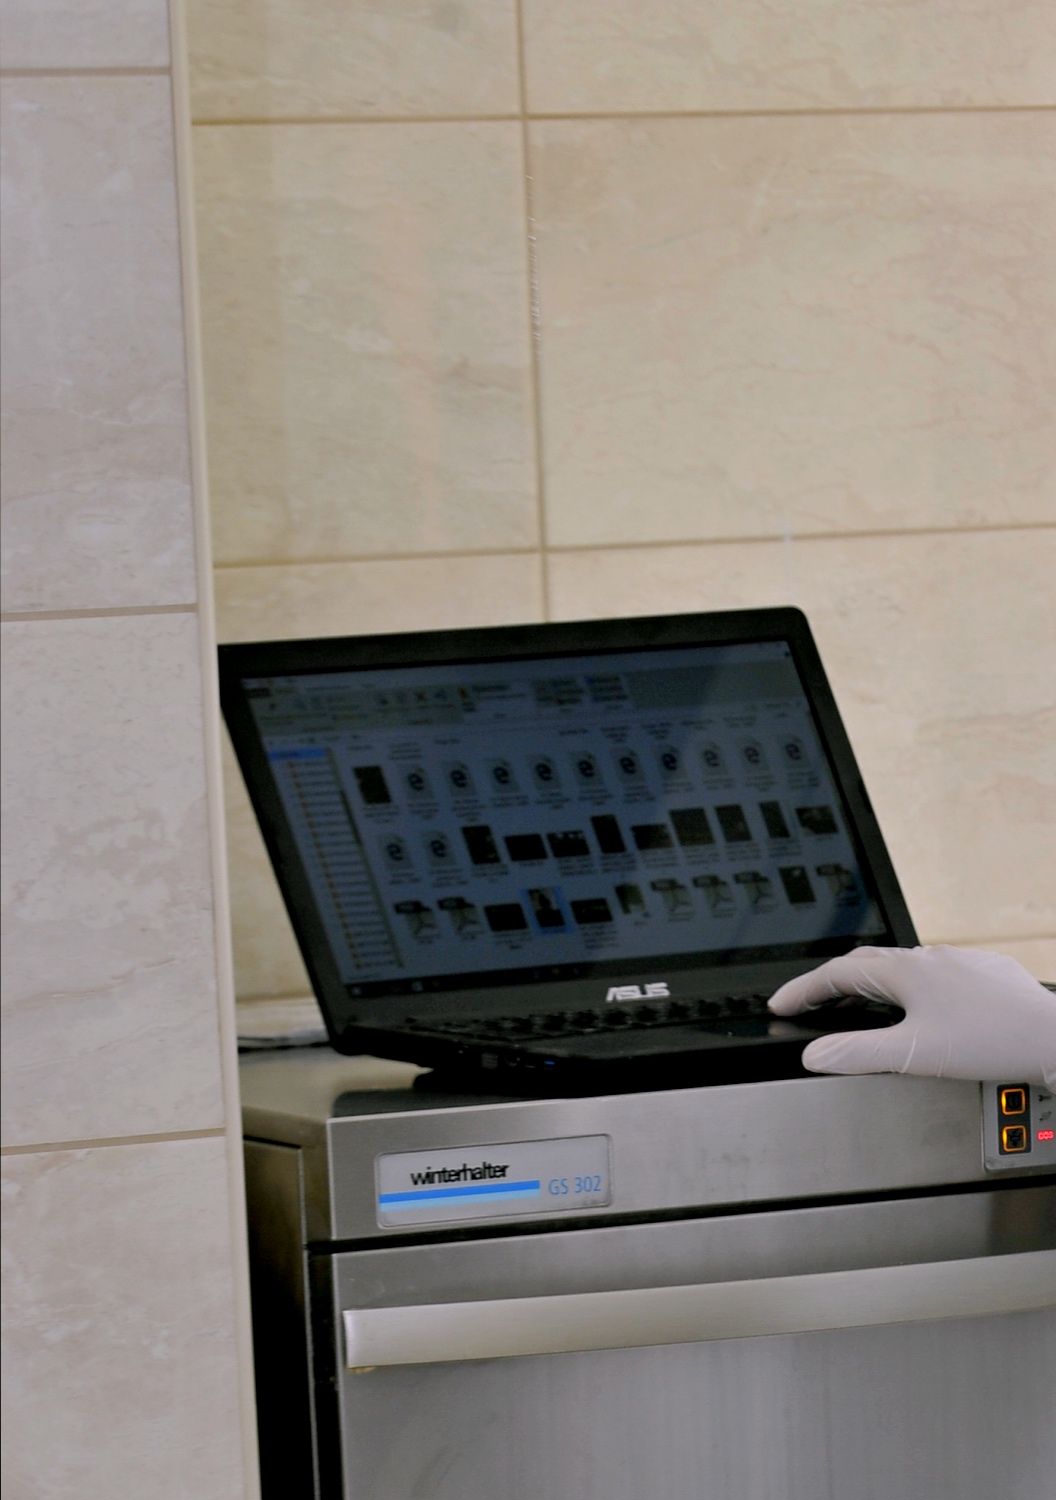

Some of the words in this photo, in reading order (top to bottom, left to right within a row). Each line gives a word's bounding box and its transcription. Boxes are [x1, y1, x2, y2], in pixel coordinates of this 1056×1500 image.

[605, 981, 671, 1002] ASUS
[410, 1161, 510, 1186] winterhalter
[548, 1178, 569, 1195] GS
[574, 1175, 602, 1193] 302
